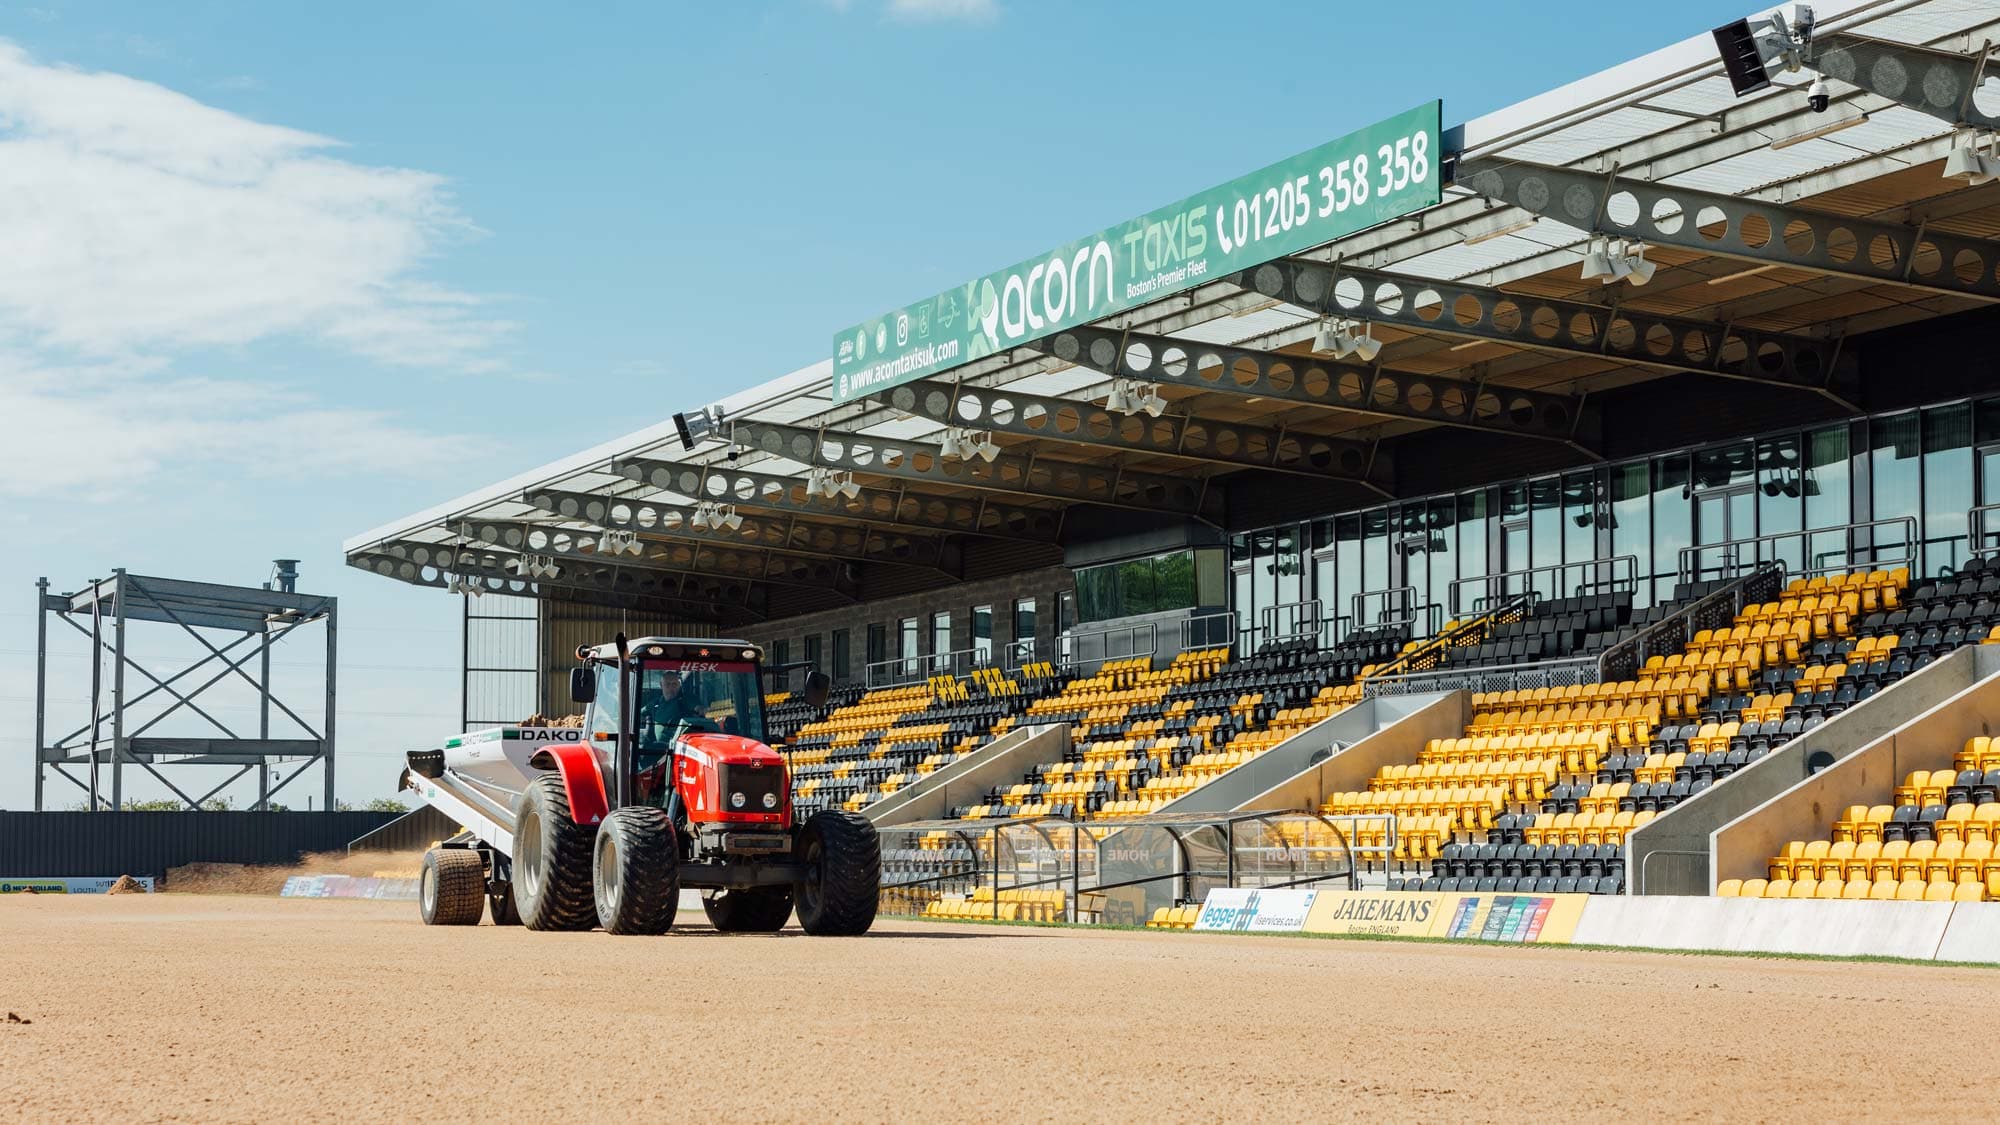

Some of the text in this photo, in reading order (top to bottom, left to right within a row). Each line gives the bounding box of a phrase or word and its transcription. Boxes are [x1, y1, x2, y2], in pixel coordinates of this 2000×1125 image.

[1233, 130, 1429, 248] 01205 358 358
[1002, 240, 1114, 338] acorn
[1127, 258, 1207, 299] Boston's Premier Fleet
[850, 339, 958, 391] www.acorntaxisuk.com
[680, 661, 719, 672] HESK
[521, 730, 583, 741] DAKO
[1266, 848, 1310, 862] HOME
[1333, 899, 1432, 922] JAKEMANS
[1368, 925, 1400, 934] ENGLAND
